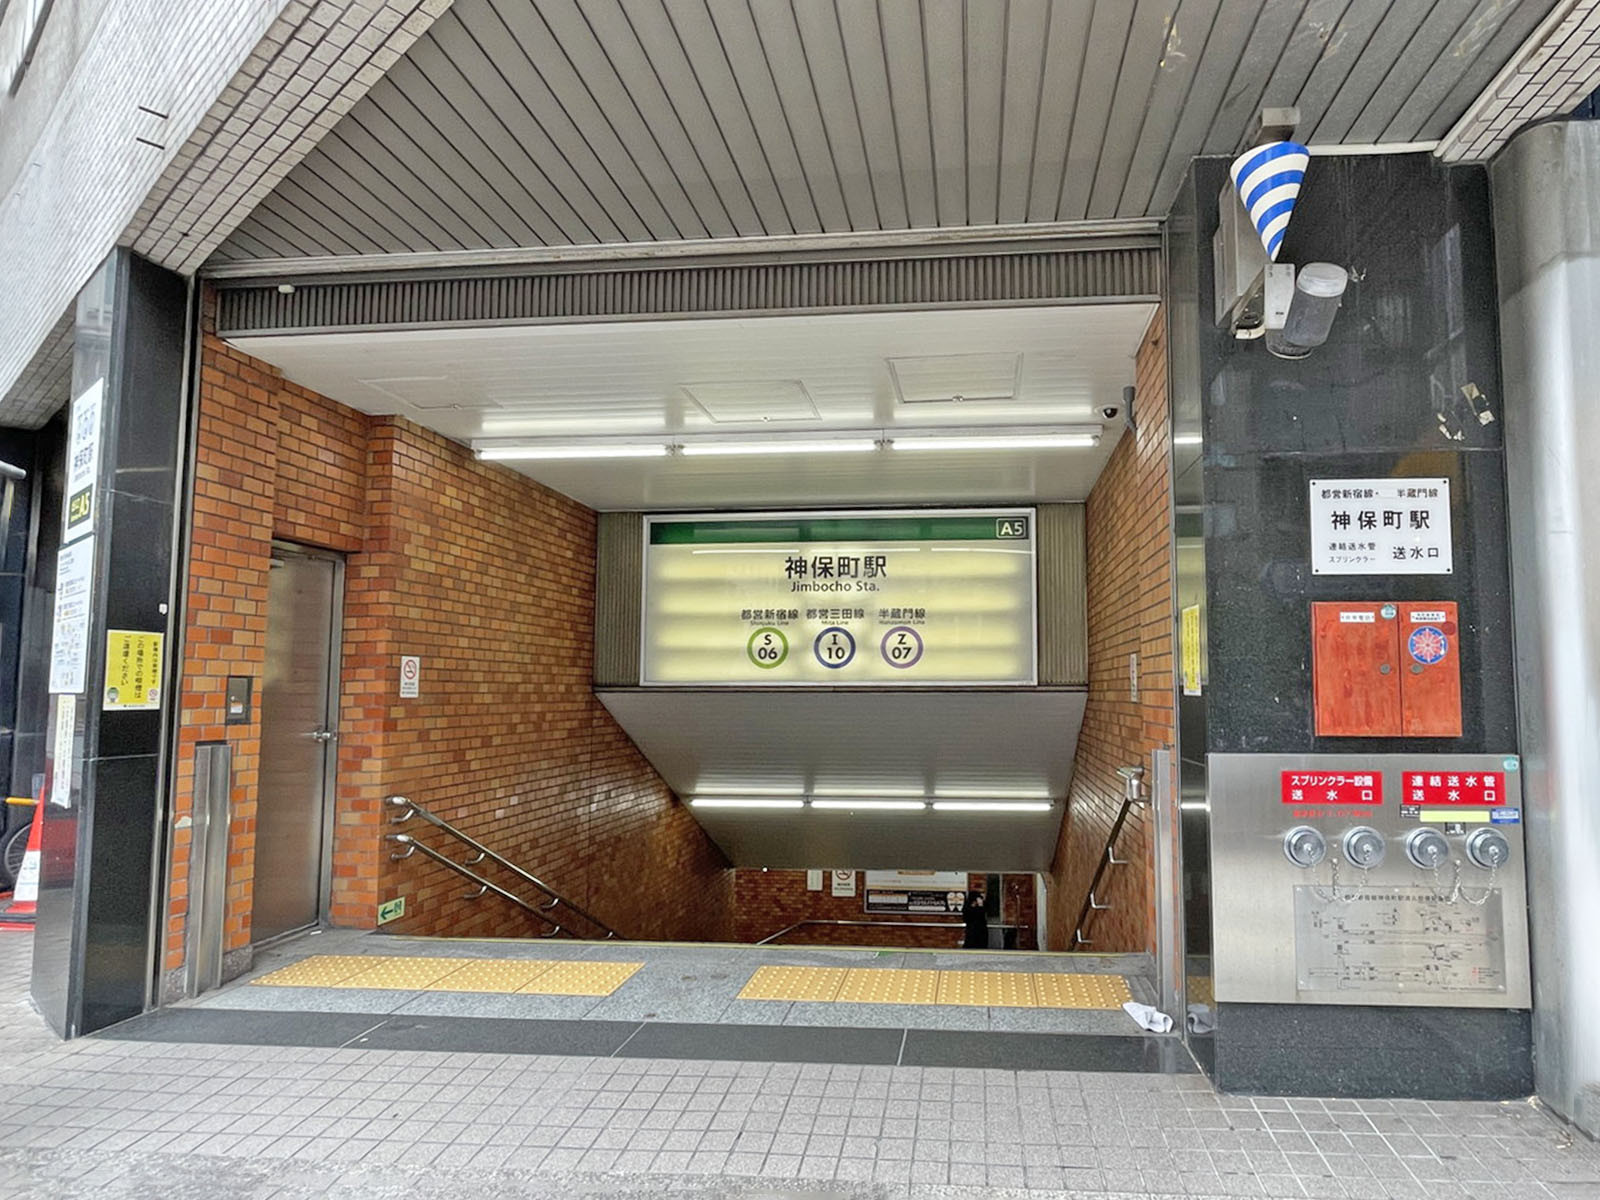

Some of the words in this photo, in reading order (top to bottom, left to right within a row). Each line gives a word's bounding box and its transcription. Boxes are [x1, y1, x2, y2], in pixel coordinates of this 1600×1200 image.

[1397, 488, 1439, 499] 半蔵門線
[1331, 510, 1430, 531] 神保町駅
[1000, 521, 1023, 535] A5
[1329, 542, 1376, 551] 連結送水管
[1392, 546, 1440, 560] 送水口
[1328, 556, 1376, 564] スプリンクラー
[785, 555, 887, 579] 神保町駅
[791, 581, 852, 592] Jimbocho
[855, 581, 880, 592] Sta.
[741, 608, 799, 620] 都営新宿線
[806, 608, 865, 619] 都営三田線
[879, 608, 926, 619] 半蔵門線
[764, 634, 773, 646] S
[832, 634, 839, 646] I
[897, 633, 907, 645] Z
[757, 647, 778, 660] 06
[826, 647, 846, 660] 10
[891, 646, 913, 660] 07
[1291, 775, 1374, 787] スプリンクラー設備
[1411, 775, 1496, 787] 連結送水管
[1291, 789, 1373, 801] 送水口
[1412, 789, 1496, 801] 送水口
